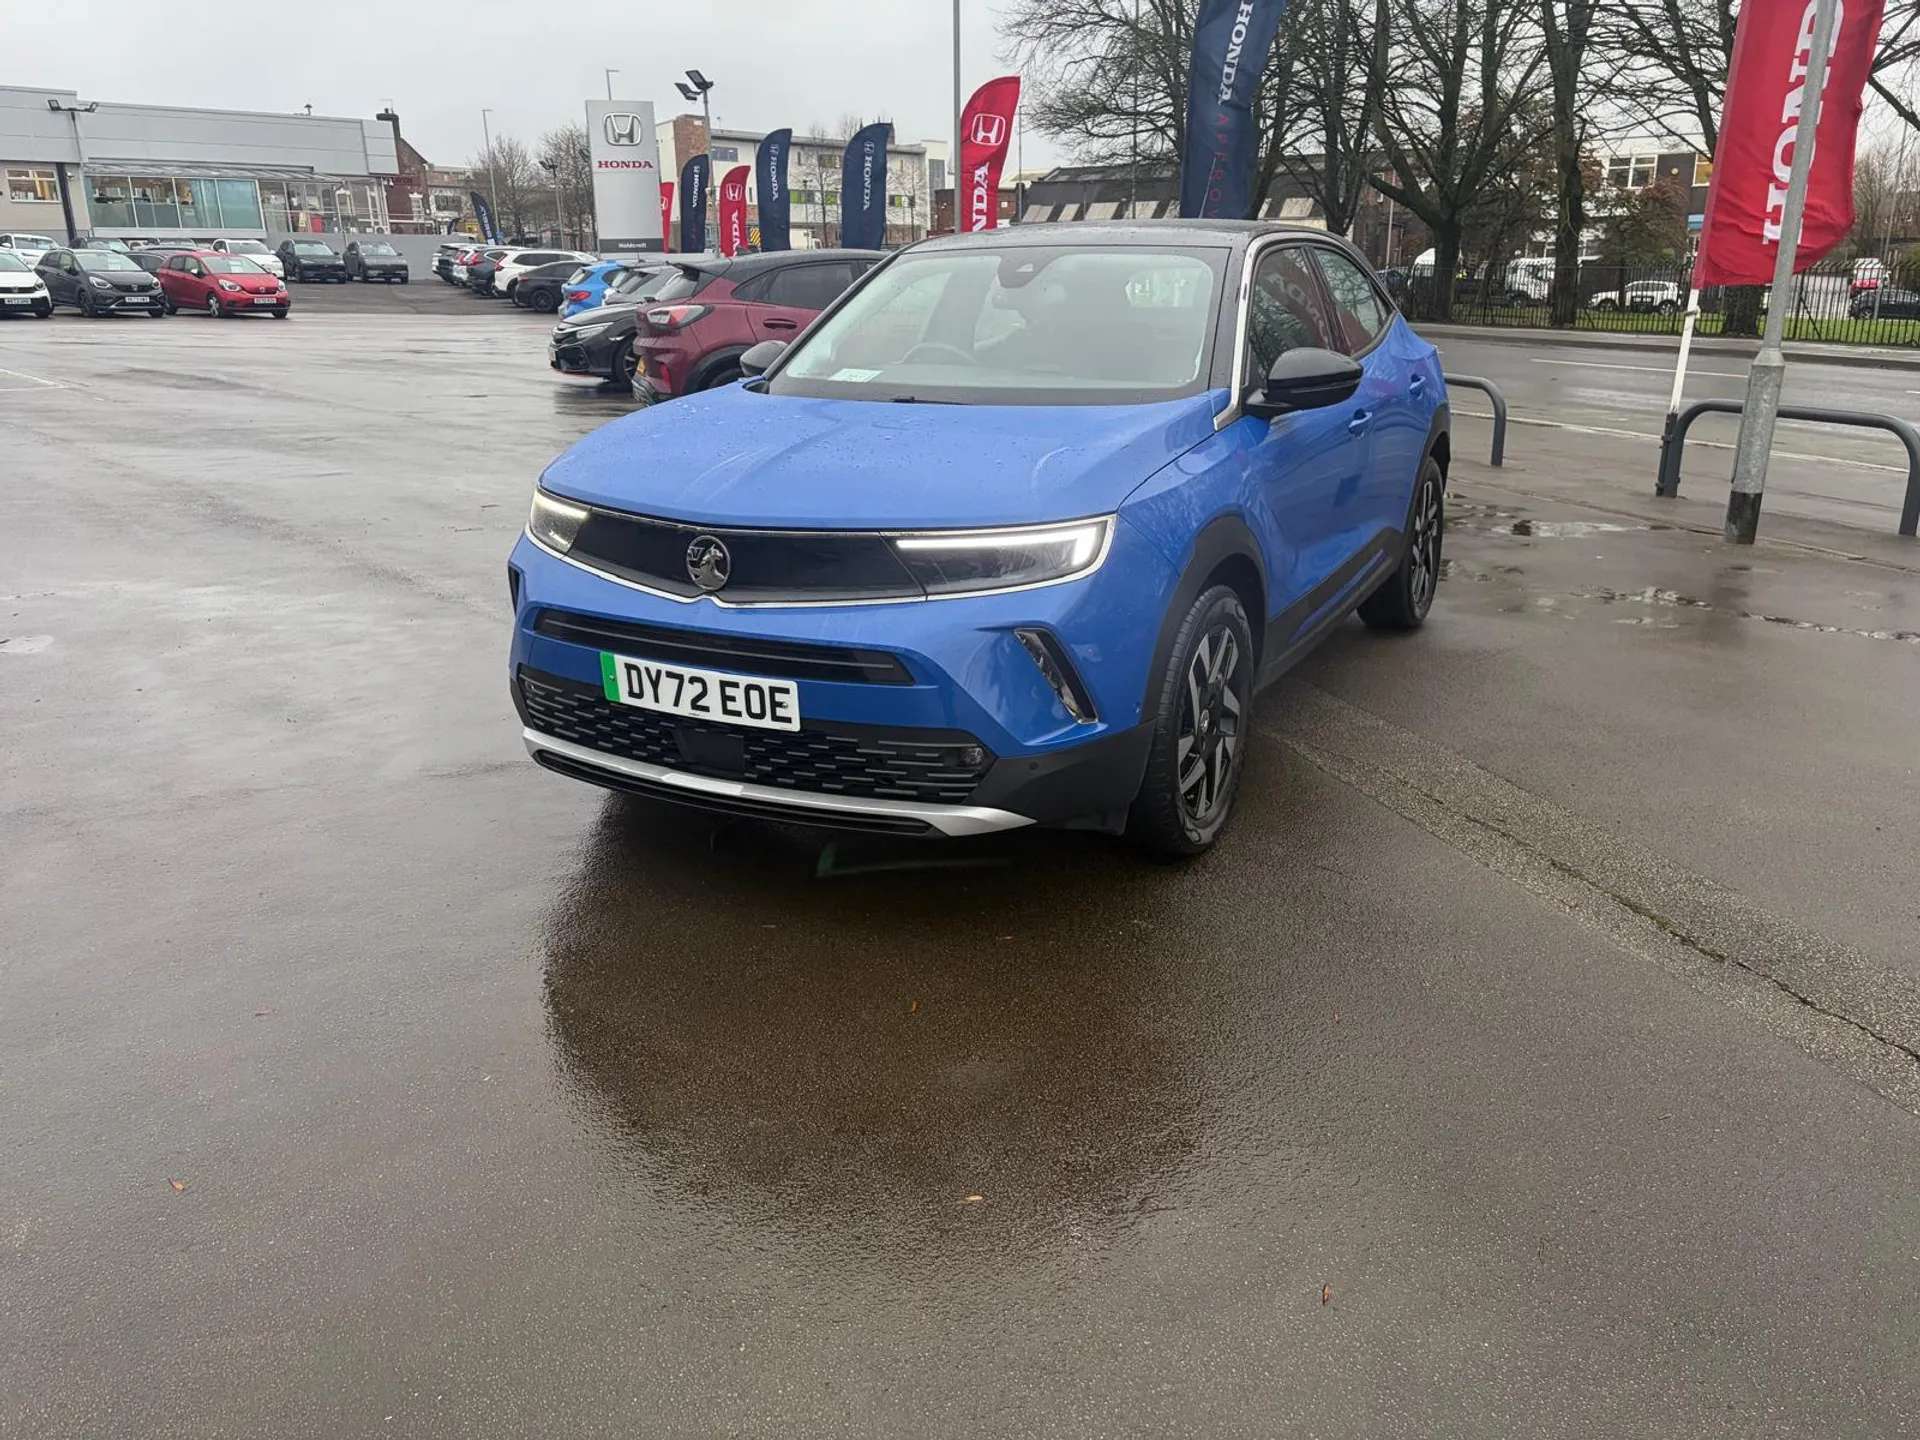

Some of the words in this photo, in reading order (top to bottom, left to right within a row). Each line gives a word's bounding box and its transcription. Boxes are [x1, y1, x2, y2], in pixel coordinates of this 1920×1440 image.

[1218, 0, 1254, 104] HONDA
[597, 160, 653, 169] HONDA
[769, 157, 779, 201] HONDA
[863, 156, 873, 211] HONDA
[692, 173, 700, 208] HONDA
[624, 662, 710, 713] DY72
[719, 679, 792, 724] EOE
